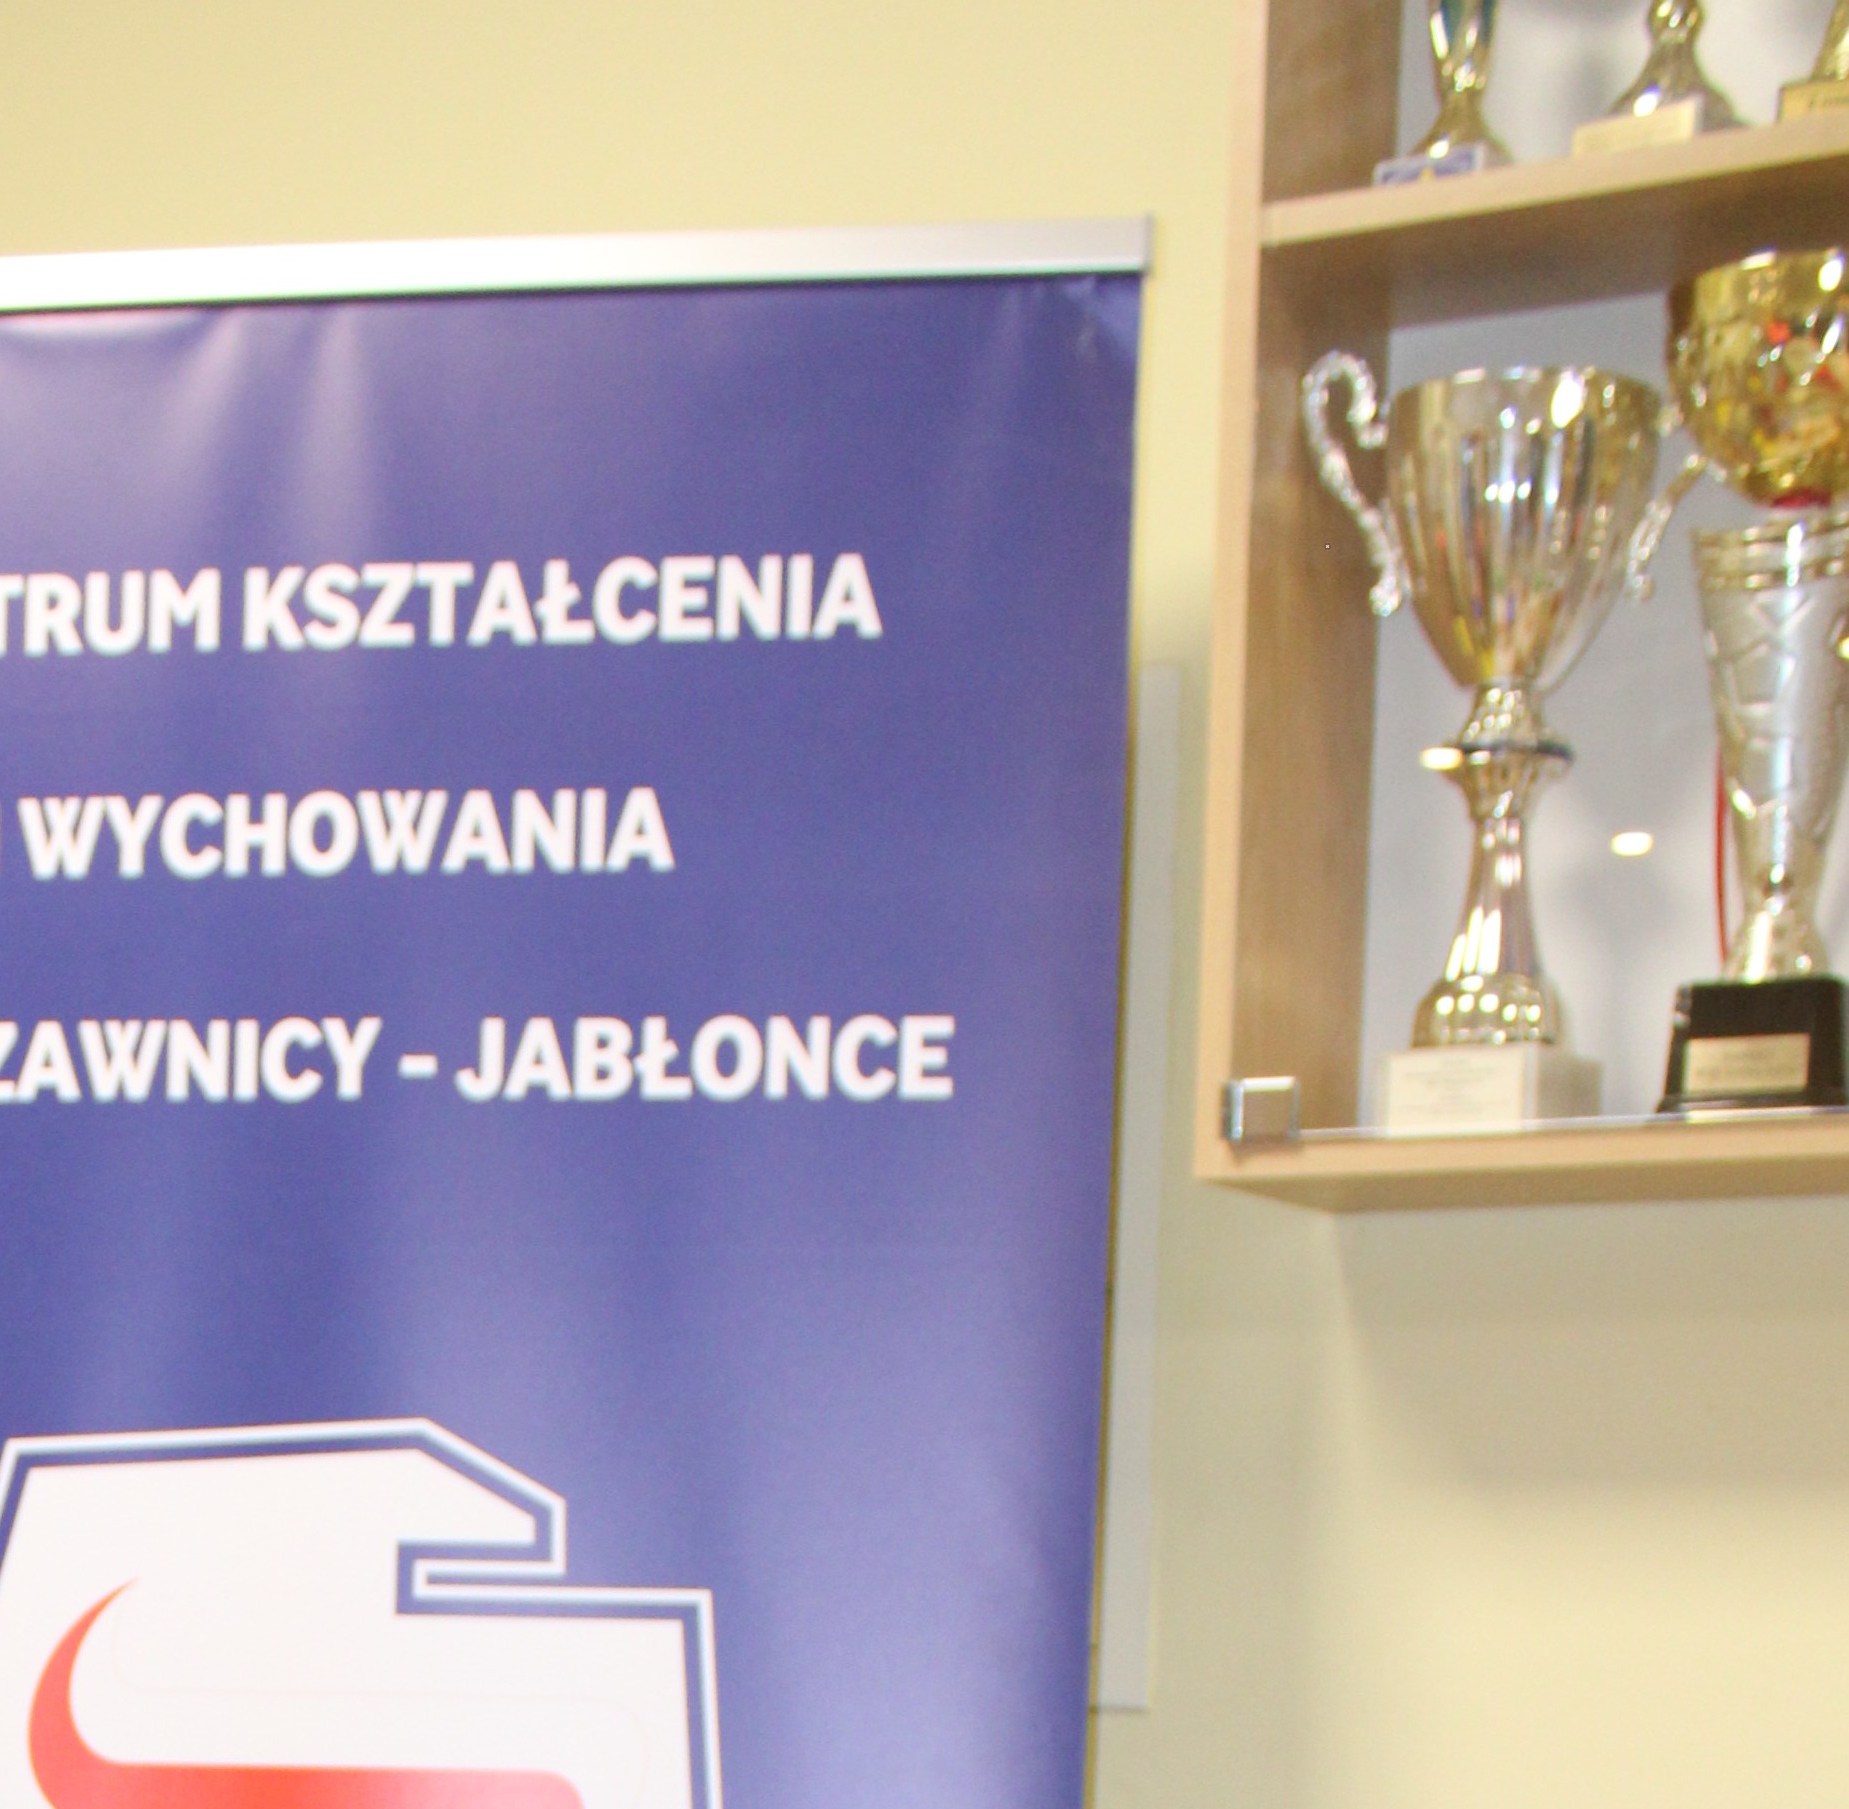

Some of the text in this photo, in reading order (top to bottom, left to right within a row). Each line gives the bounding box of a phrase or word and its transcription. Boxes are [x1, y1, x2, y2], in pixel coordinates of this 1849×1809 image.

[243, 555, 882, 650] KSZTAŁCENIA
[18, 788, 675, 879] WYCHOWANIA
[456, 1015, 955, 1101] JABŁONCE
